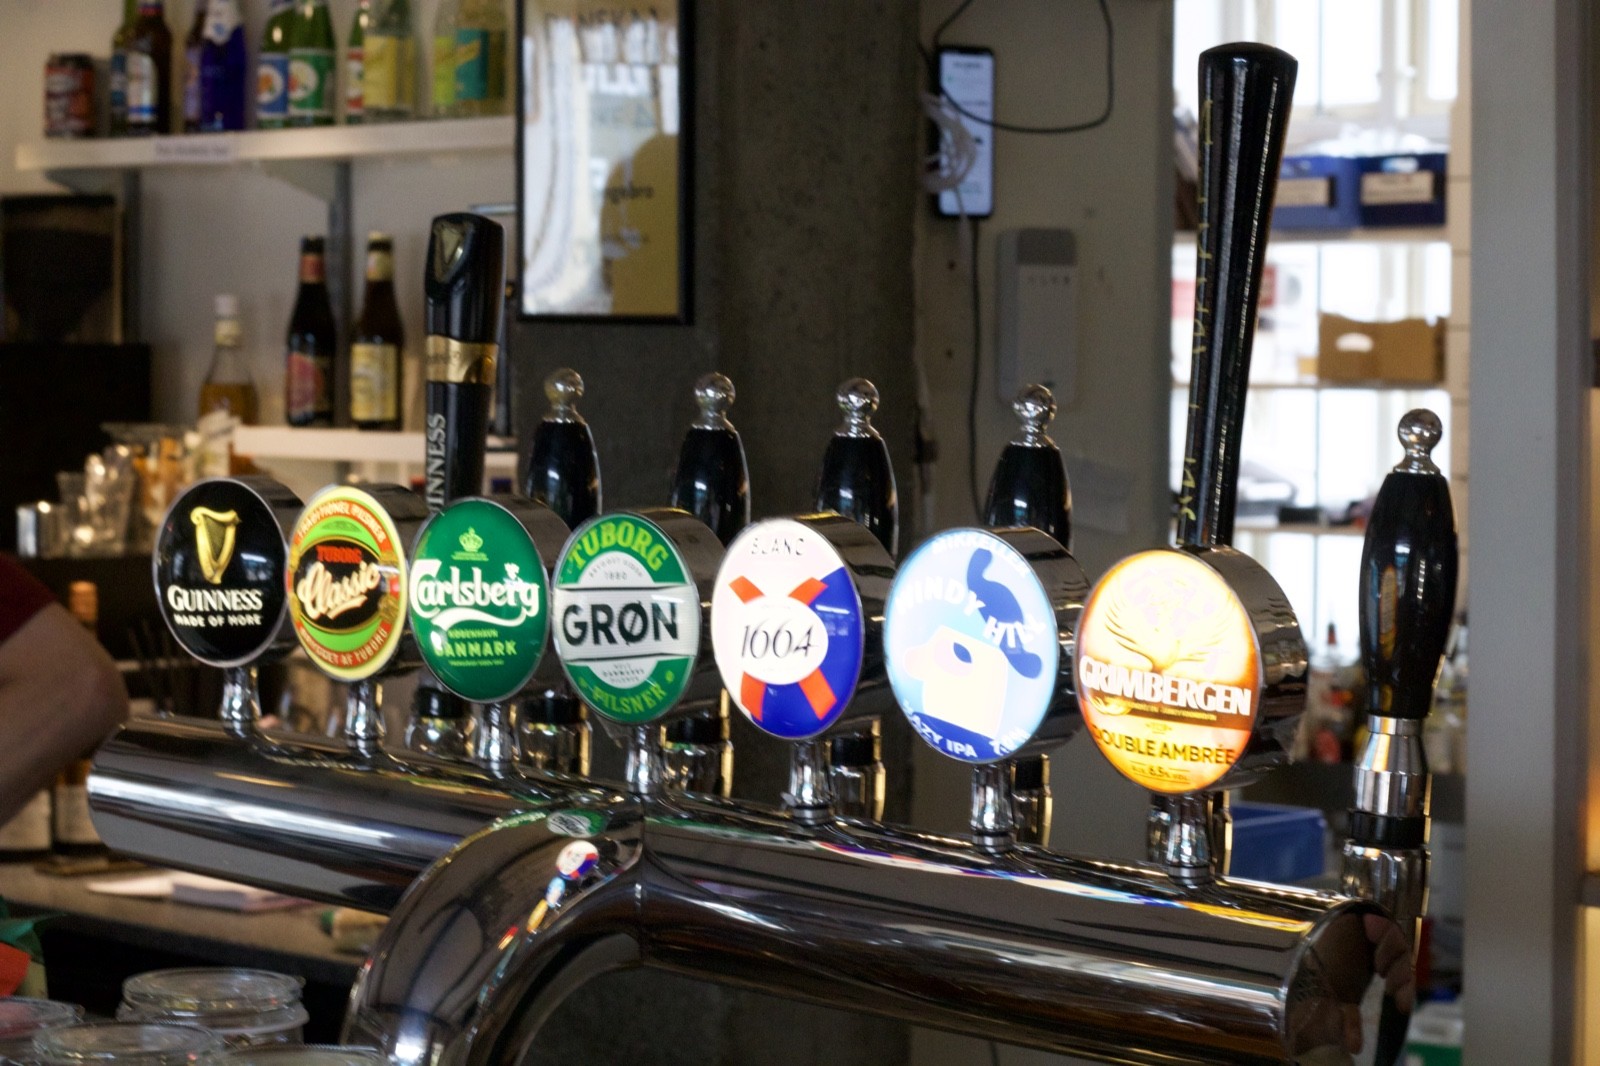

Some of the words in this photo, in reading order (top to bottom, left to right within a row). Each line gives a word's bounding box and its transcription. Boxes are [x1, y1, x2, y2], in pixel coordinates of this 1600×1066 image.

[426, 413, 446, 512] INNESS
[570, 520, 669, 571] TUBORG
[167, 585, 263, 612] GUINNESS
[297, 561, 380, 620] Classic
[409, 558, 540, 619] Carlsberg
[895, 576, 986, 616] WINDY
[174, 614, 205, 627] MADE
[209, 615, 225, 627] OF
[228, 614, 262, 626] MORE
[562, 599, 679, 647] GRØN
[741, 616, 820, 660] 1664
[592, 683, 668, 714] PILSNER
[1079, 656, 1252, 716] GRIMBERGEN
[946, 739, 978, 758] IPA
[1091, 724, 1157, 758] DOUBLE
[1159, 743, 1236, 765] AMBRÉE
